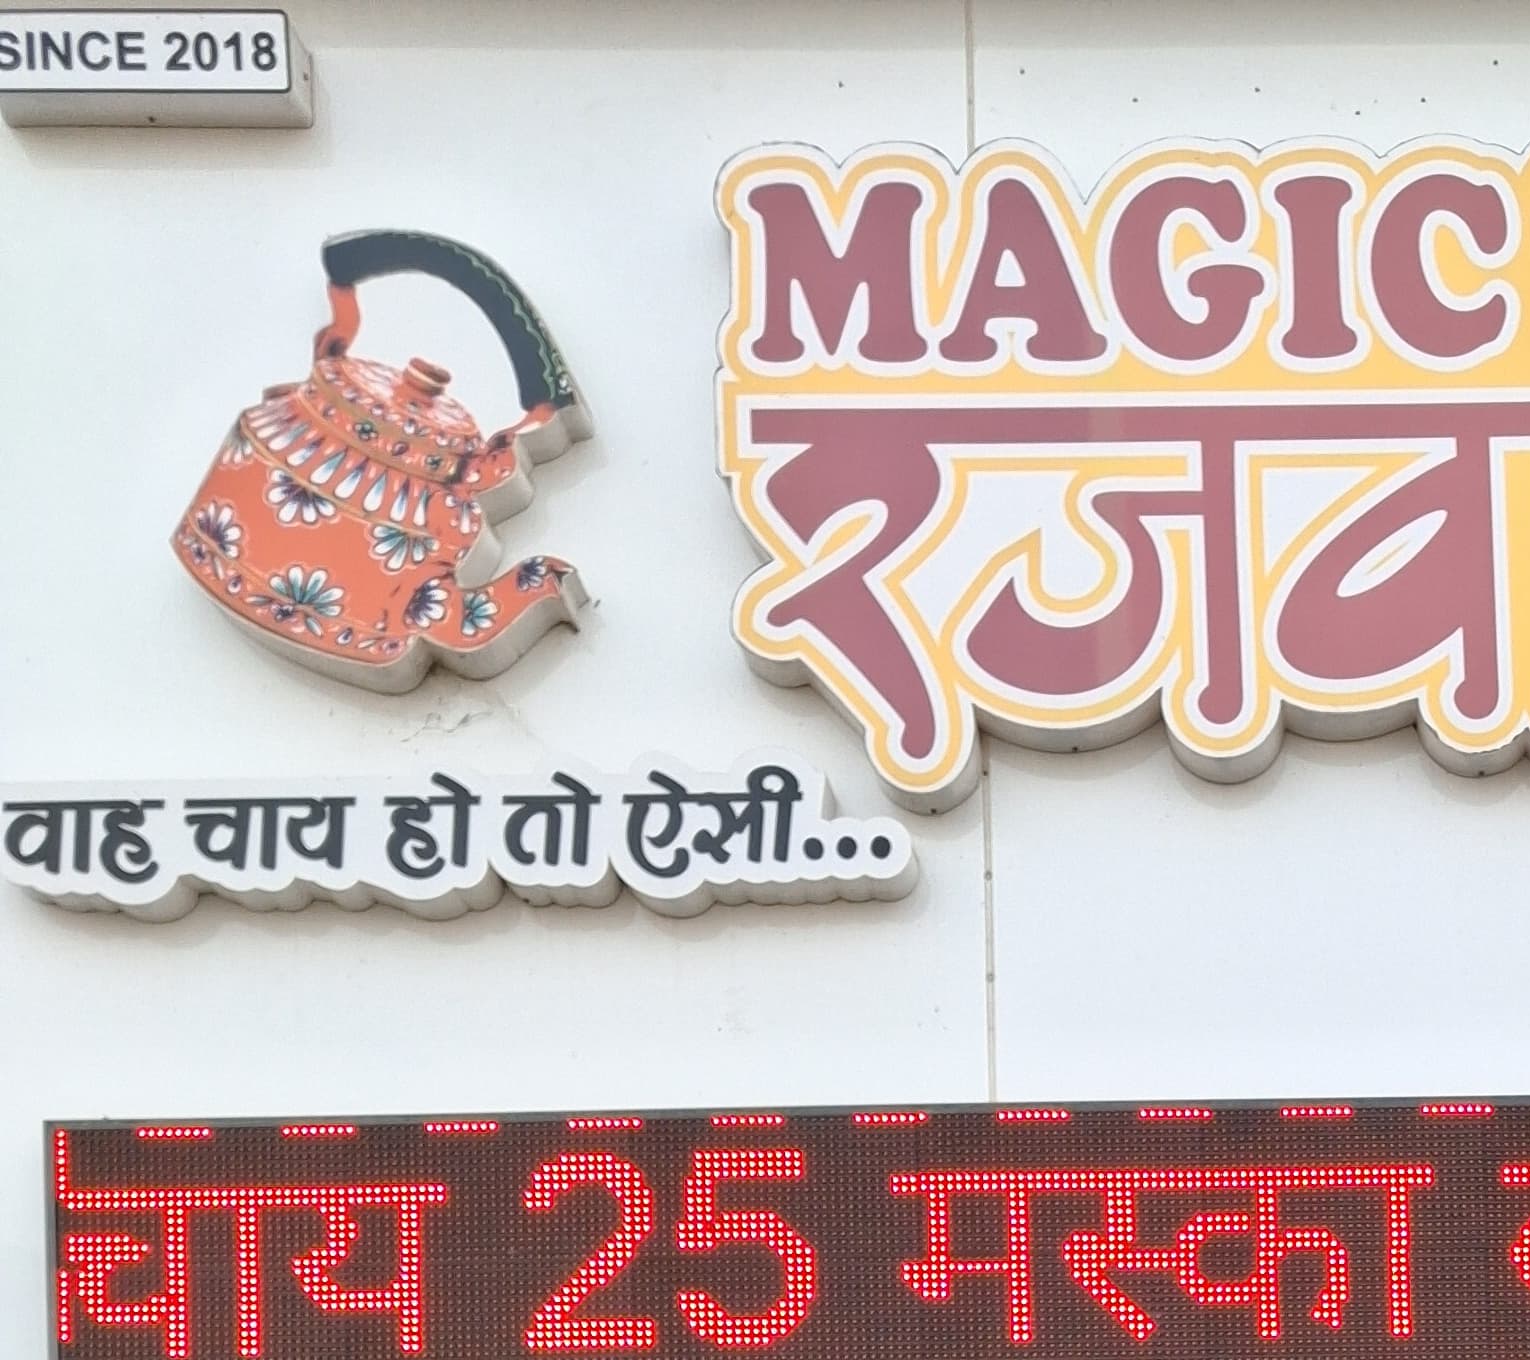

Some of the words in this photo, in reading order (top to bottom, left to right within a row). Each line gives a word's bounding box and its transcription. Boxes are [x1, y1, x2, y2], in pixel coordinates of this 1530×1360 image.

[0, 31, 147, 71] SINCE
[163, 31, 277, 71] 2018
[746, 172, 1508, 367] MAGIC
[4, 799, 164, 881] वाह
[185, 797, 356, 870] चाय
[385, 773, 480, 877] हो
[502, 773, 600, 868] तो
[60, 1183, 447, 1358] चाय
[523, 1150, 816, 1351] 25
[890, 1164, 1434, 1345] मस्का
